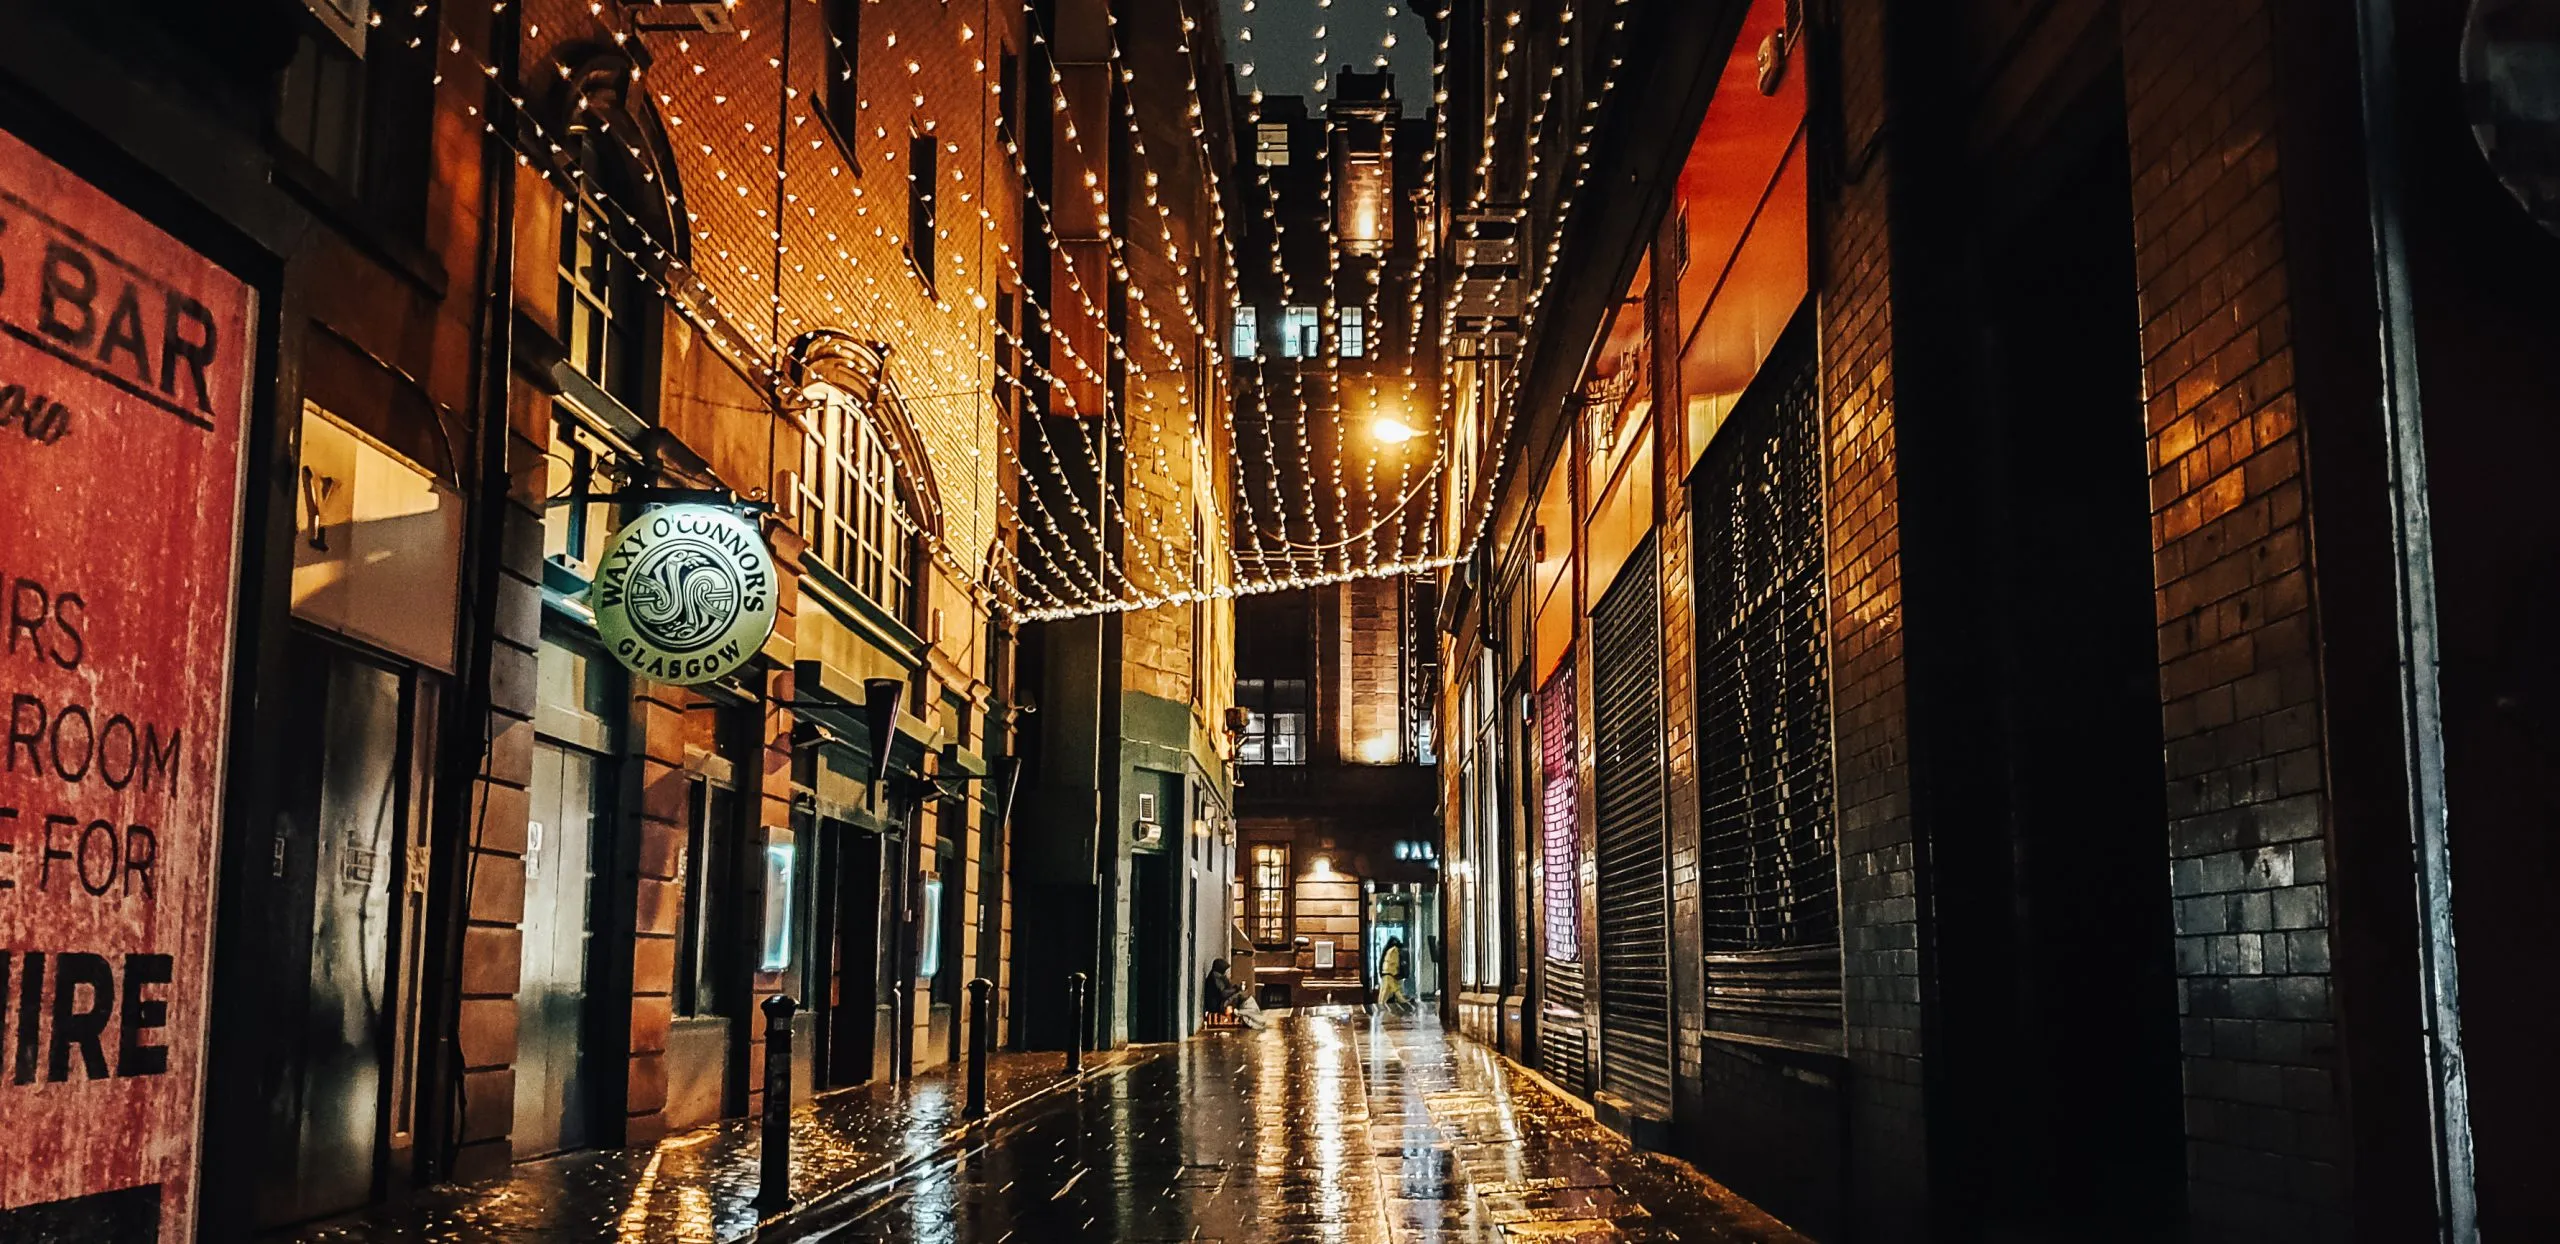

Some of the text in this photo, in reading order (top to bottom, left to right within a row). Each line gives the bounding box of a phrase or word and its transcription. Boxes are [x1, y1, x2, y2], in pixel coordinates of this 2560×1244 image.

[39, 240, 216, 416] BAR
[602, 514, 766, 612] WAXY O'CONNOR'S
[618, 639, 740, 679] GLASGOW
[8, 693, 181, 799] ROOM
[40, 814, 156, 900] FOR
